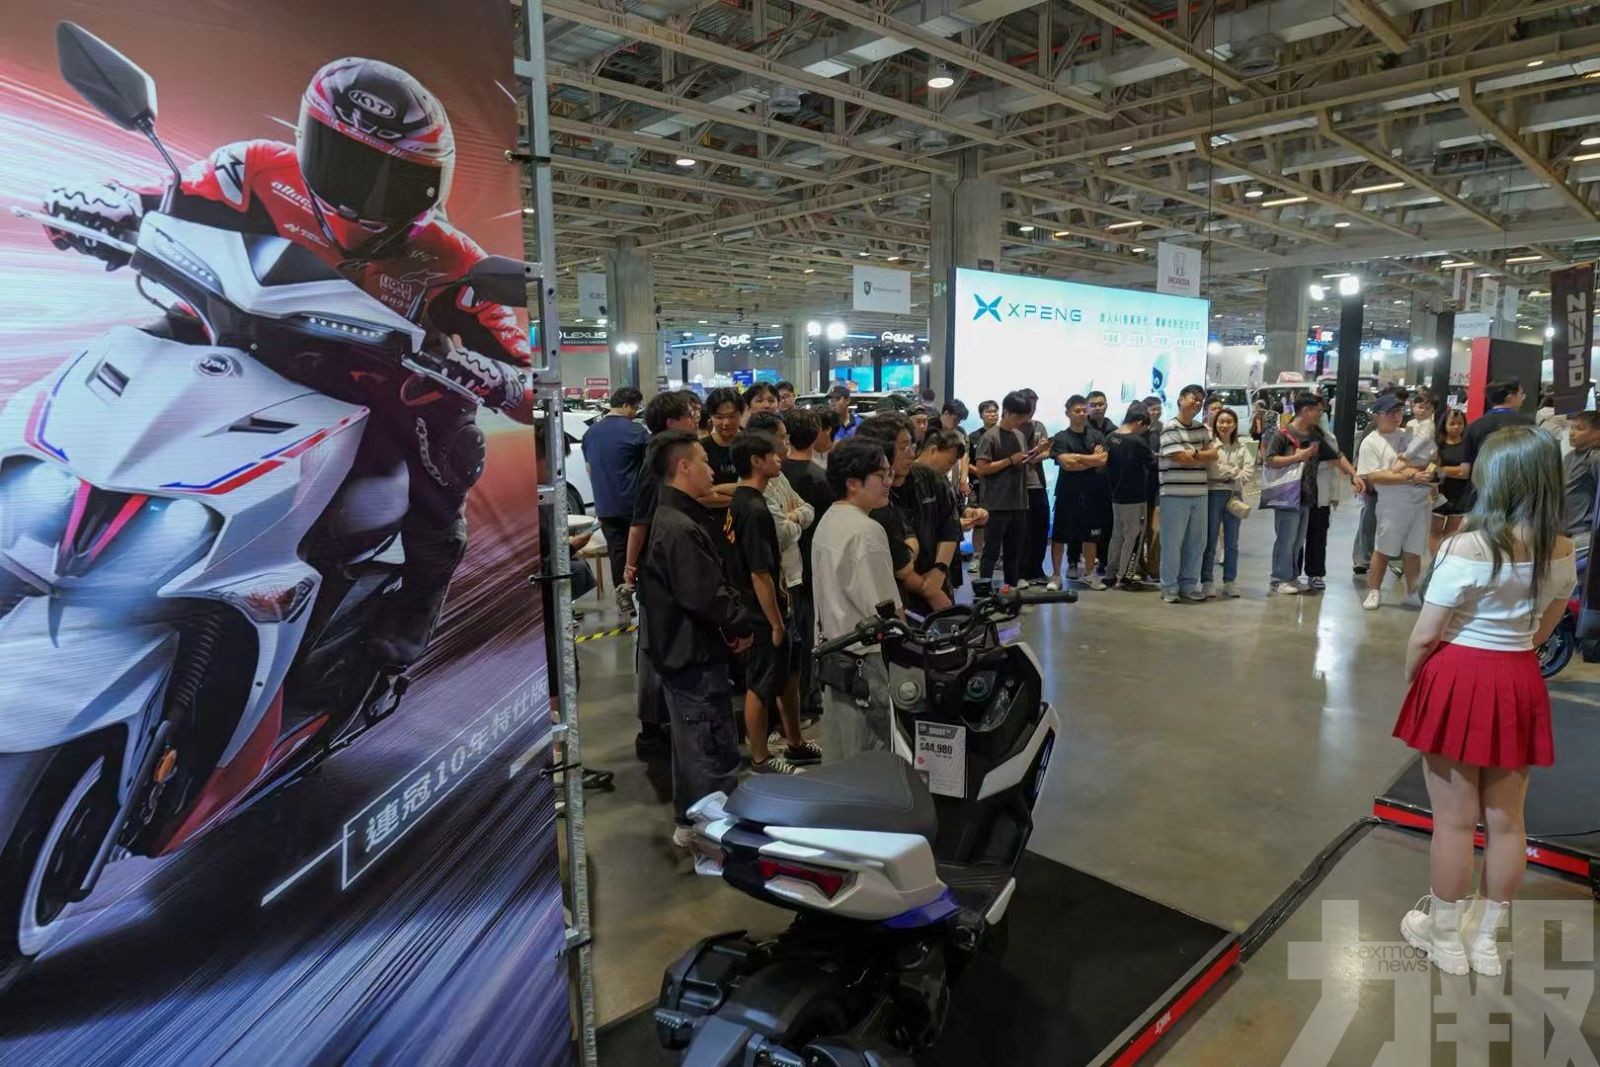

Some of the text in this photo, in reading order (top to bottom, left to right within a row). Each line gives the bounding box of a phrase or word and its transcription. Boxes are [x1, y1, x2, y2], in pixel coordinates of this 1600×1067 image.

[351, 91, 394, 116] KYT
[1008, 303, 1082, 322] XPENG
[563, 331, 607, 339] LEXUS
[730, 334, 751, 345] GAC
[893, 333, 915, 343] GAC
[919, 743, 952, 754] $44,980
